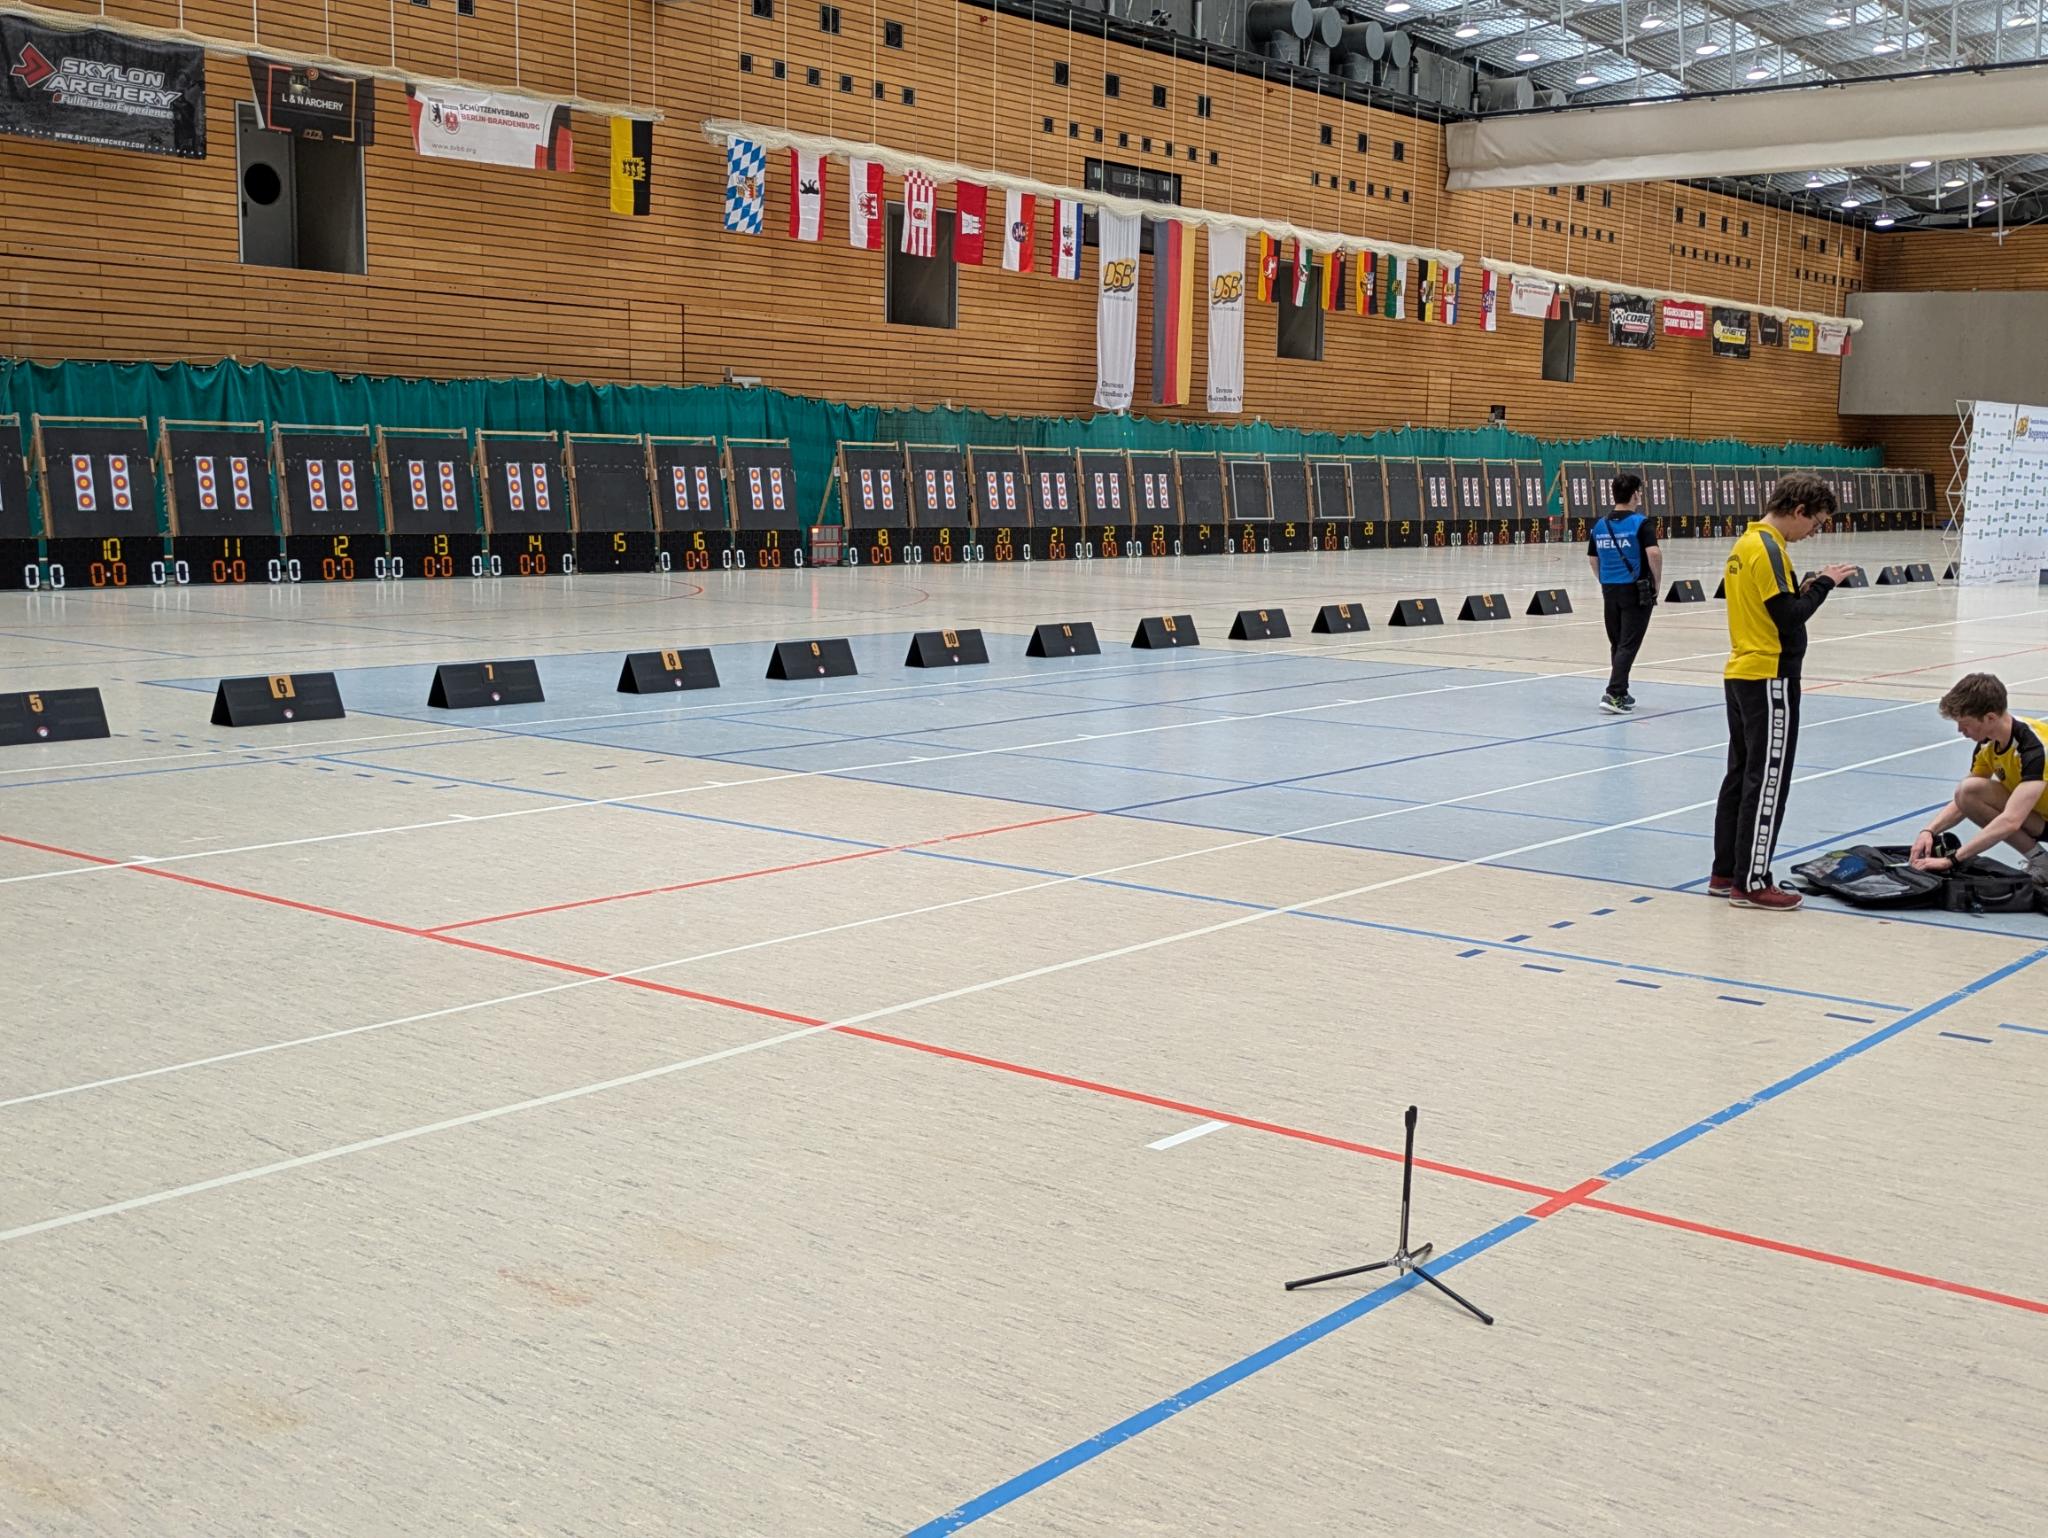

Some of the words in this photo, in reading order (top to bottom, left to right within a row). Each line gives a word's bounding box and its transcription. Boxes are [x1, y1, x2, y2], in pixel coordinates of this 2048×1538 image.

[62, 57, 165, 89] SKYLON
[45, 74, 183, 109] ARCHERY
[61, 93, 174, 119] FullCarbonExperience
[282, 93, 288, 103] L
[289, 95, 296, 103] &
[298, 96, 304, 105] N
[305, 98, 344, 111] ARCHERY
[459, 104, 530, 119] SCHÜTZENVERBAND
[1104, 260, 1135, 292] DSB
[1213, 273, 1242, 304] DSB
[1625, 313, 1650, 324] CORE
[693, 532, 705, 550] 16
[766, 531, 778, 548] 17
[878, 529, 888, 545] 18
[940, 528, 950, 545] 19
[997, 528, 1011, 544] 20
[1051, 527, 1064, 543] 21
[1103, 526, 1115, 541] 22
[1153, 525, 1165, 540] 23
[103, 539, 121, 561] 10
[224, 539, 241, 557] 11
[334, 536, 349, 557] 12
[434, 535, 449, 556] 13
[528, 535, 541, 552] 14
[614, 533, 626, 552] 15
[1076, 542, 1082, 558] 0
[1086, 542, 1093, 558] 0
[1126, 541, 1133, 556] 0
[1135, 541, 1142, 556] 0
[1174, 540, 1180, 555] 0
[1228, 538, 1234, 553] 0
[1263, 537, 1270, 552] 0
[1312, 536, 1318, 550] 0
[1344, 535, 1350, 550] 0
[661, 552, 671, 571] 0
[723, 550, 731, 568] 0
[736, 550, 745, 568] 0
[794, 548, 803, 567] 0
[849, 547, 858, 565] 0
[904, 545, 912, 564] 0
[914, 546, 922, 563] 0
[963, 545, 971, 562] 0
[976, 545, 984, 562] 0
[1023, 544, 1031, 560] 0
[175, 560, 190, 584] 0
[268, 559, 280, 582] 0
[288, 559, 301, 581] 0
[374, 557, 386, 579] 0
[392, 557, 404, 578] 0
[473, 556, 483, 576] 0
[491, 556, 501, 575] 0
[563, 554, 572, 574] 0
[25, 564, 39, 588] 0
[49, 564, 64, 588] 0
[151, 560, 166, 584] 0
[945, 633, 957, 645] 10
[1062, 625, 1072, 637] 11
[811, 642, 820, 656] 9
[667, 653, 676, 667] 8
[484, 664, 495, 681] 7
[275, 677, 288, 695] 6
[29, 694, 45, 712] 5
